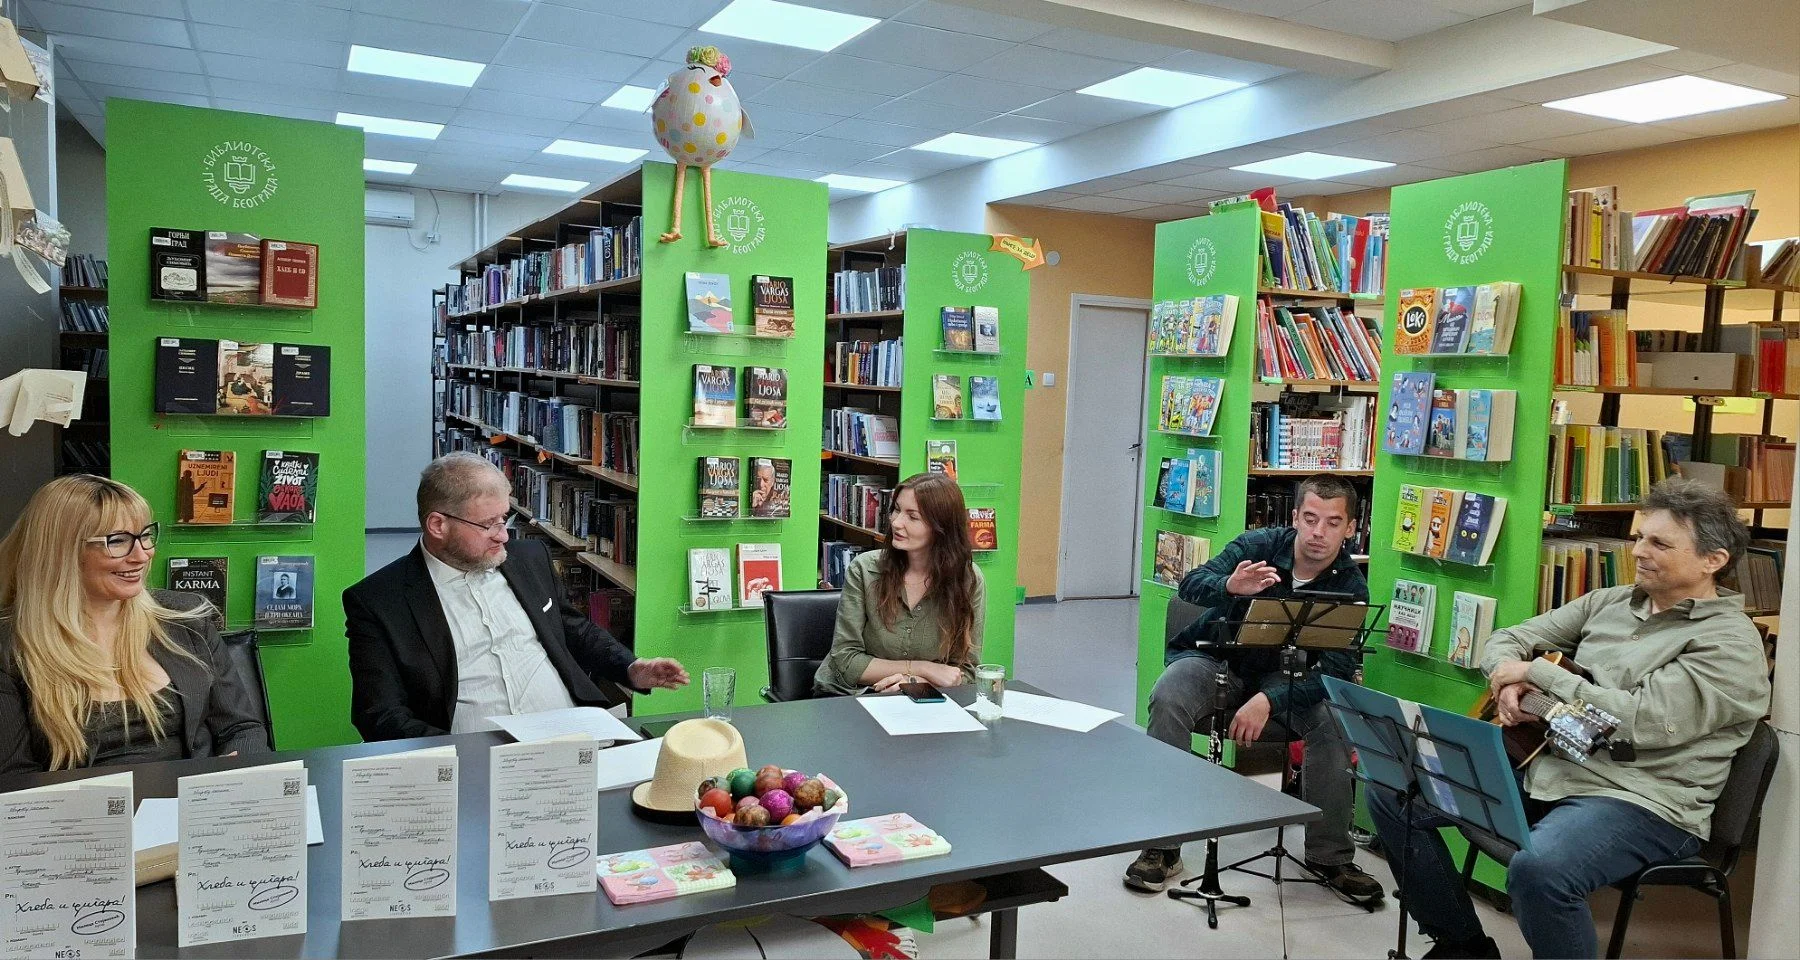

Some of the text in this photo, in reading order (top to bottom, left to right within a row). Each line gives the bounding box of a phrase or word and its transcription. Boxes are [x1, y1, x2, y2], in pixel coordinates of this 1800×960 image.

[203, 141, 276, 172] БИБЛИОТЕКА
[202, 172, 278, 209] ГРАДА БЕОГРАДА
[713, 196, 765, 223] БИБЛИОТЕКА
[1445, 201, 1493, 230] БИБЛИОТЕКА
[168, 231, 190, 240] ГОРЊИ
[733, 227, 766, 255] БЕОГРАДА
[171, 240, 188, 249] ГРАД
[1460, 230, 1494, 265] БЕОГРАДА
[760, 286, 789, 297] VARGAS
[764, 293, 788, 304] LJOSA
[701, 374, 730, 386] VARGAS
[758, 372, 781, 382] MARIO
[758, 385, 782, 396] LJOSA
[188, 463, 228, 471] UZNEMIRENI
[197, 469, 219, 477] LJUDI
[708, 468, 735, 478] VARGAS
[273, 474, 306, 485] ŽIVOT
[710, 475, 734, 487] LJOSA
[268, 492, 306, 510] VAOA
[969, 512, 995, 520] ORVEL
[175, 580, 220, 589] KARMA
[505, 837, 536, 850] Хлеба
[359, 856, 391, 868] Хлеба
[197, 876, 234, 891] Хлеба
[15, 898, 55, 914] Хлеба
[390, 904, 411, 912] NEOS
[233, 925, 256, 934] NEOS
[55, 949, 81, 959] NEOS
